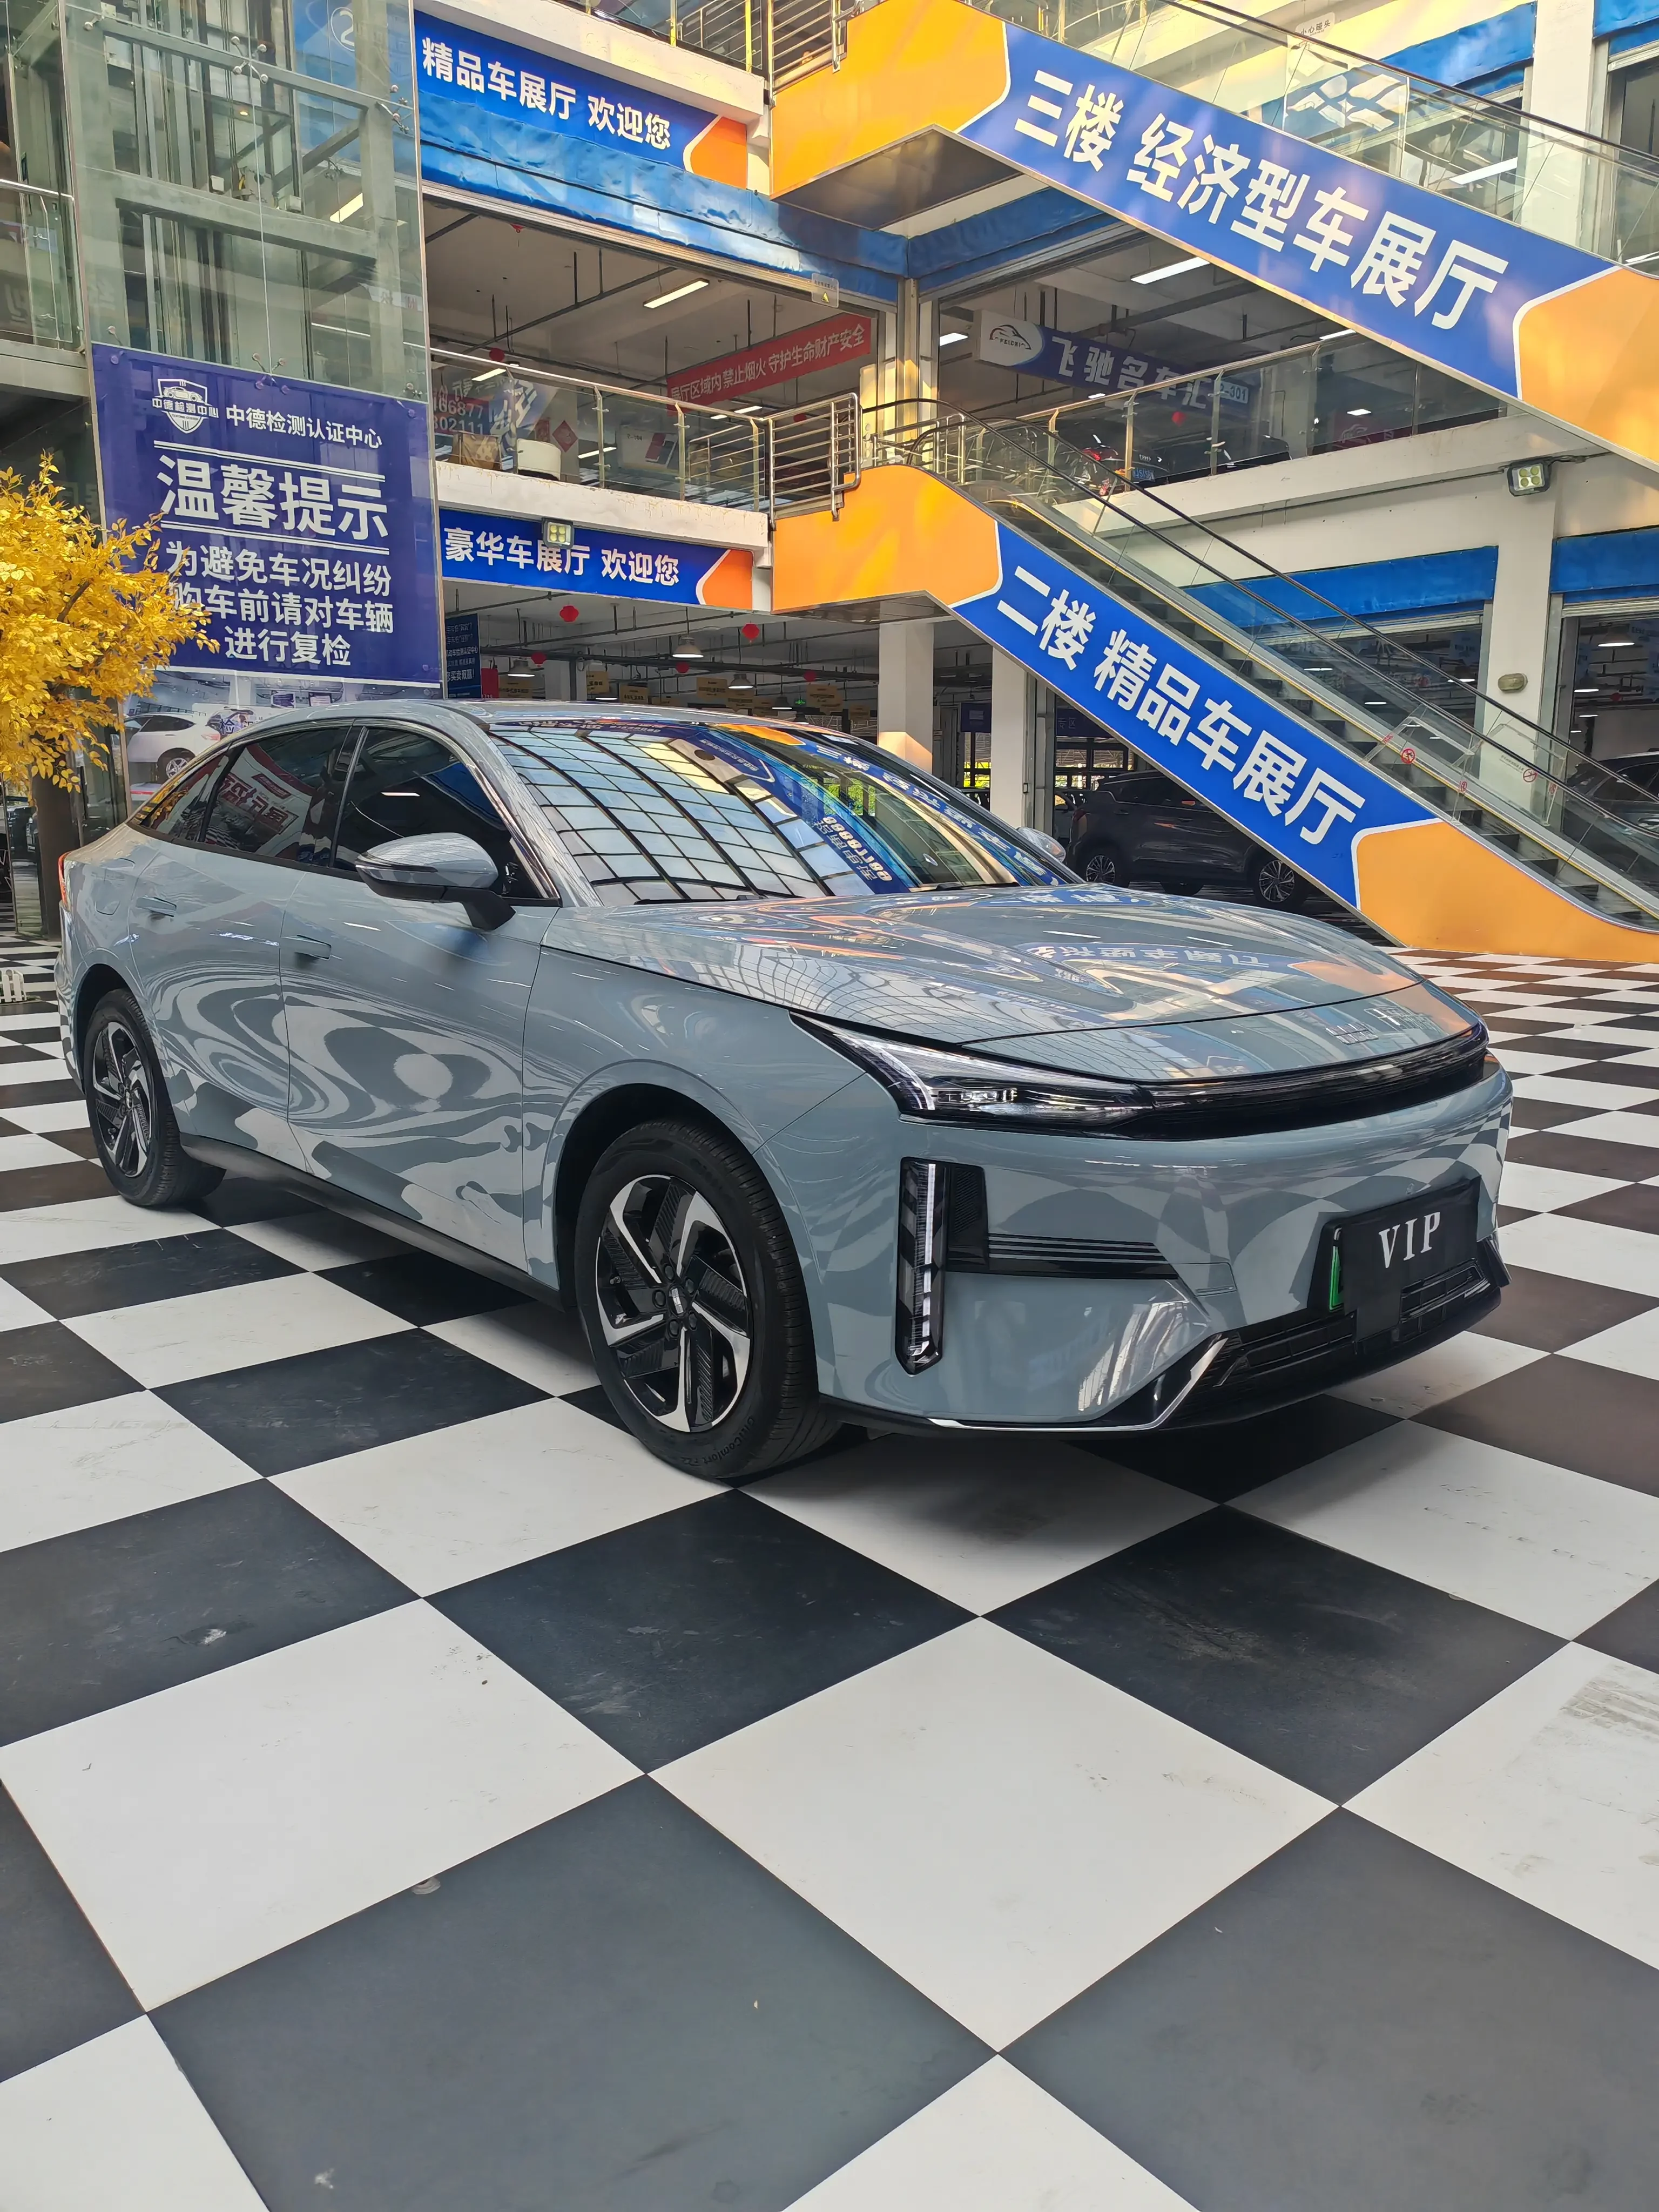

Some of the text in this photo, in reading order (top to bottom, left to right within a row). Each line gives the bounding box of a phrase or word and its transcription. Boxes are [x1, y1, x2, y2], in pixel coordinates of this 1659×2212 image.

[422, 37, 671, 150] 精品车展厅 欢迎您
[1014, 69, 1509, 331] 三楼 经济型车展厅
[1051, 335, 1212, 410] 飞驰名车汇
[226, 404, 382, 449] 中德检测认证中心
[157, 454, 389, 541] 温馨提示
[165, 541, 392, 597] 为避免车况纠纷
[444, 527, 680, 586] 豪华车展厅 欢迎您
[168, 581, 394, 634] 购车前请对车辆
[225, 626, 351, 666] 进行复检
[997, 565, 1366, 846] 二楼 精品车展厅
[1378, 1211, 1441, 1269] VIP
